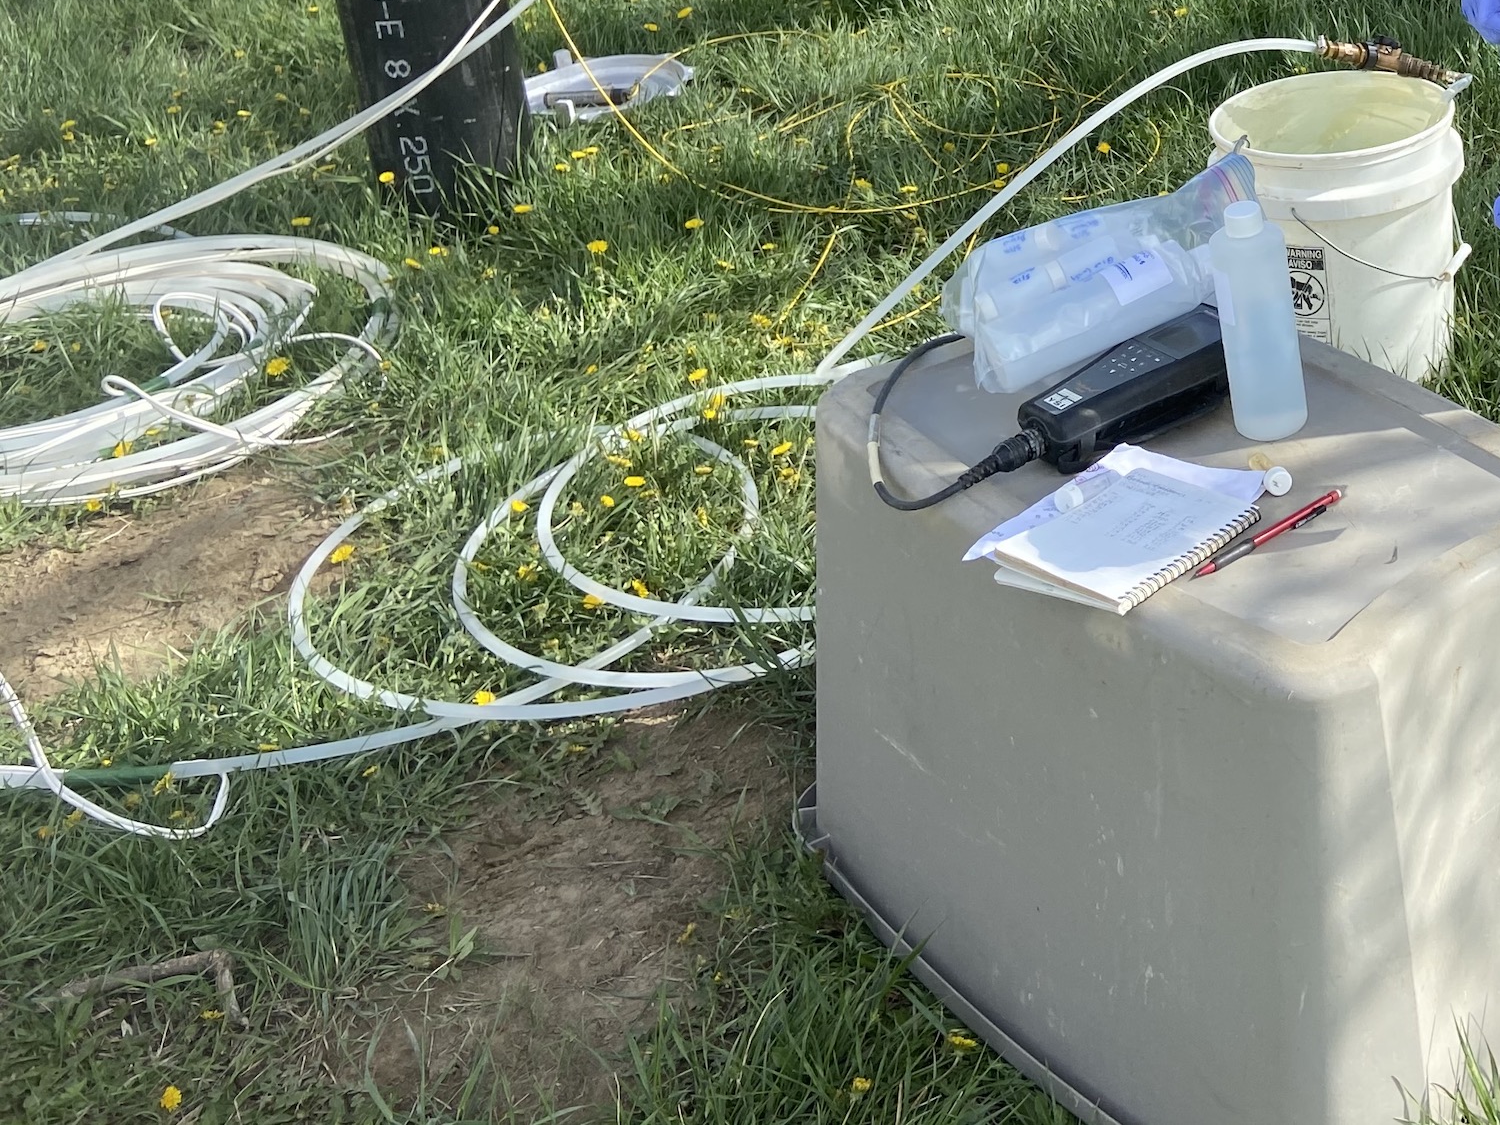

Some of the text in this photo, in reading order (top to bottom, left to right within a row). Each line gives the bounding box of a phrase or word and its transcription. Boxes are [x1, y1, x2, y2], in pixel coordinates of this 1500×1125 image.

[384, 59, 411, 79] 8
[1287, 249, 1322, 259] ARNING
[1288, 260, 1313, 270] AVISO
